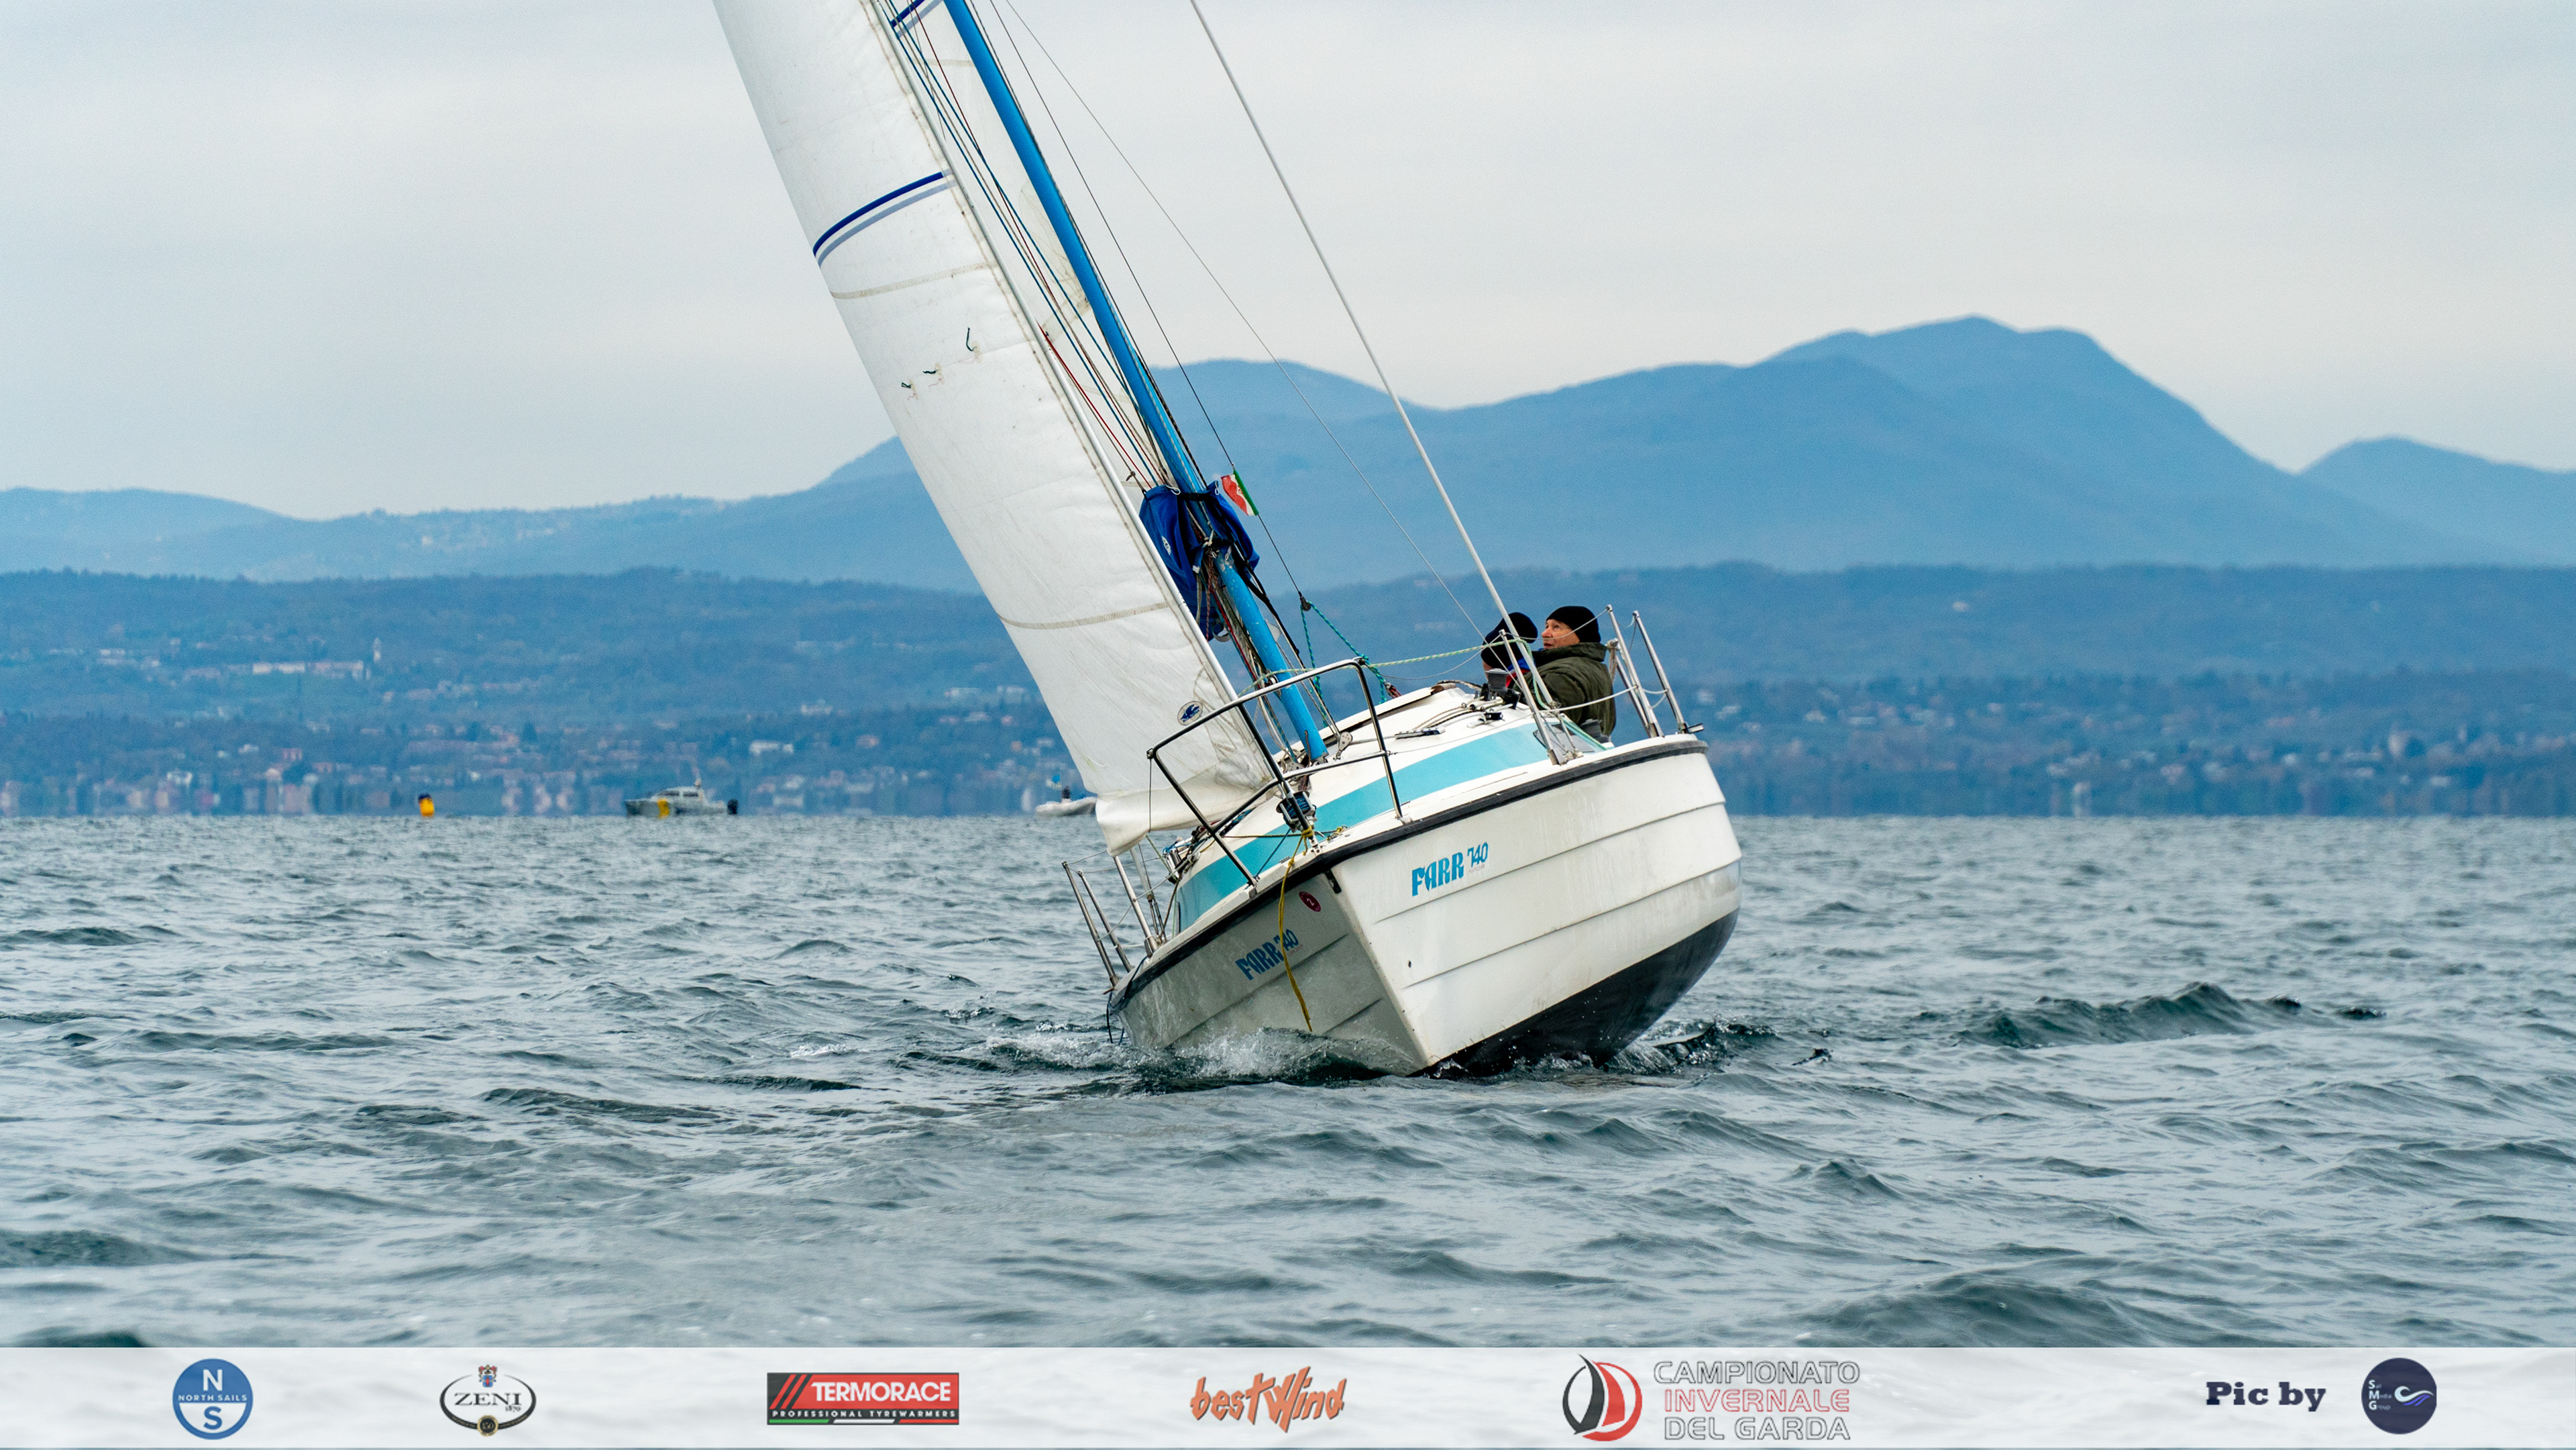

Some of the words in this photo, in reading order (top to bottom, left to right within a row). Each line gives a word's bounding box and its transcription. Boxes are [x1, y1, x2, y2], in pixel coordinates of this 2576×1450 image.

[1412, 851, 1464, 896] FARR
[1467, 841, 1489, 868] 740
[1235, 941, 1285, 980] FARR
